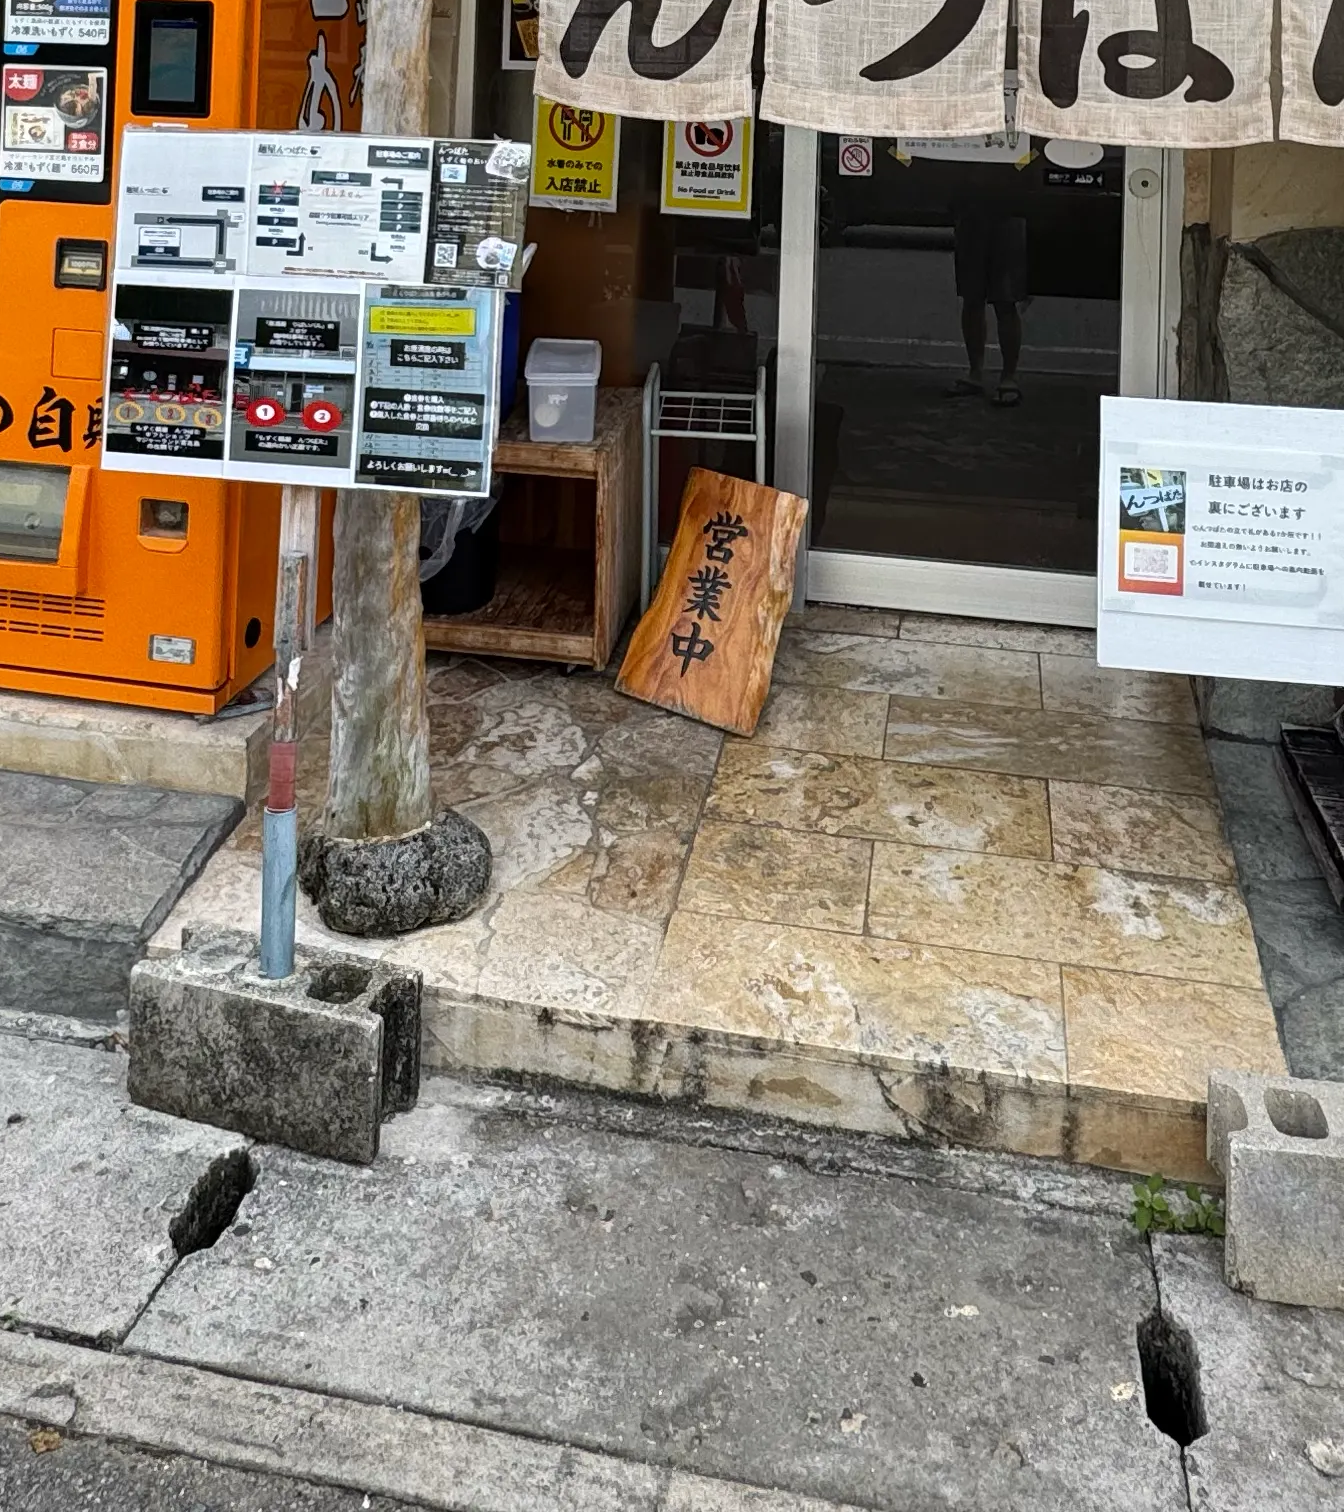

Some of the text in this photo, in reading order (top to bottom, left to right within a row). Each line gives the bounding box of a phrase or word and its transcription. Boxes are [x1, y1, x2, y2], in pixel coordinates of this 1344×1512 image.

[8, 74, 38, 90] 太麺
[545, 176, 602, 194] 入店禁止
[689, 186, 707, 194] Food
[716, 188, 736, 196] Drink
[1208, 474, 1308, 493] 駐車場はお店の
[1208, 501, 1307, 520] 裏にございます
[671, 511, 749, 678] 営業中
